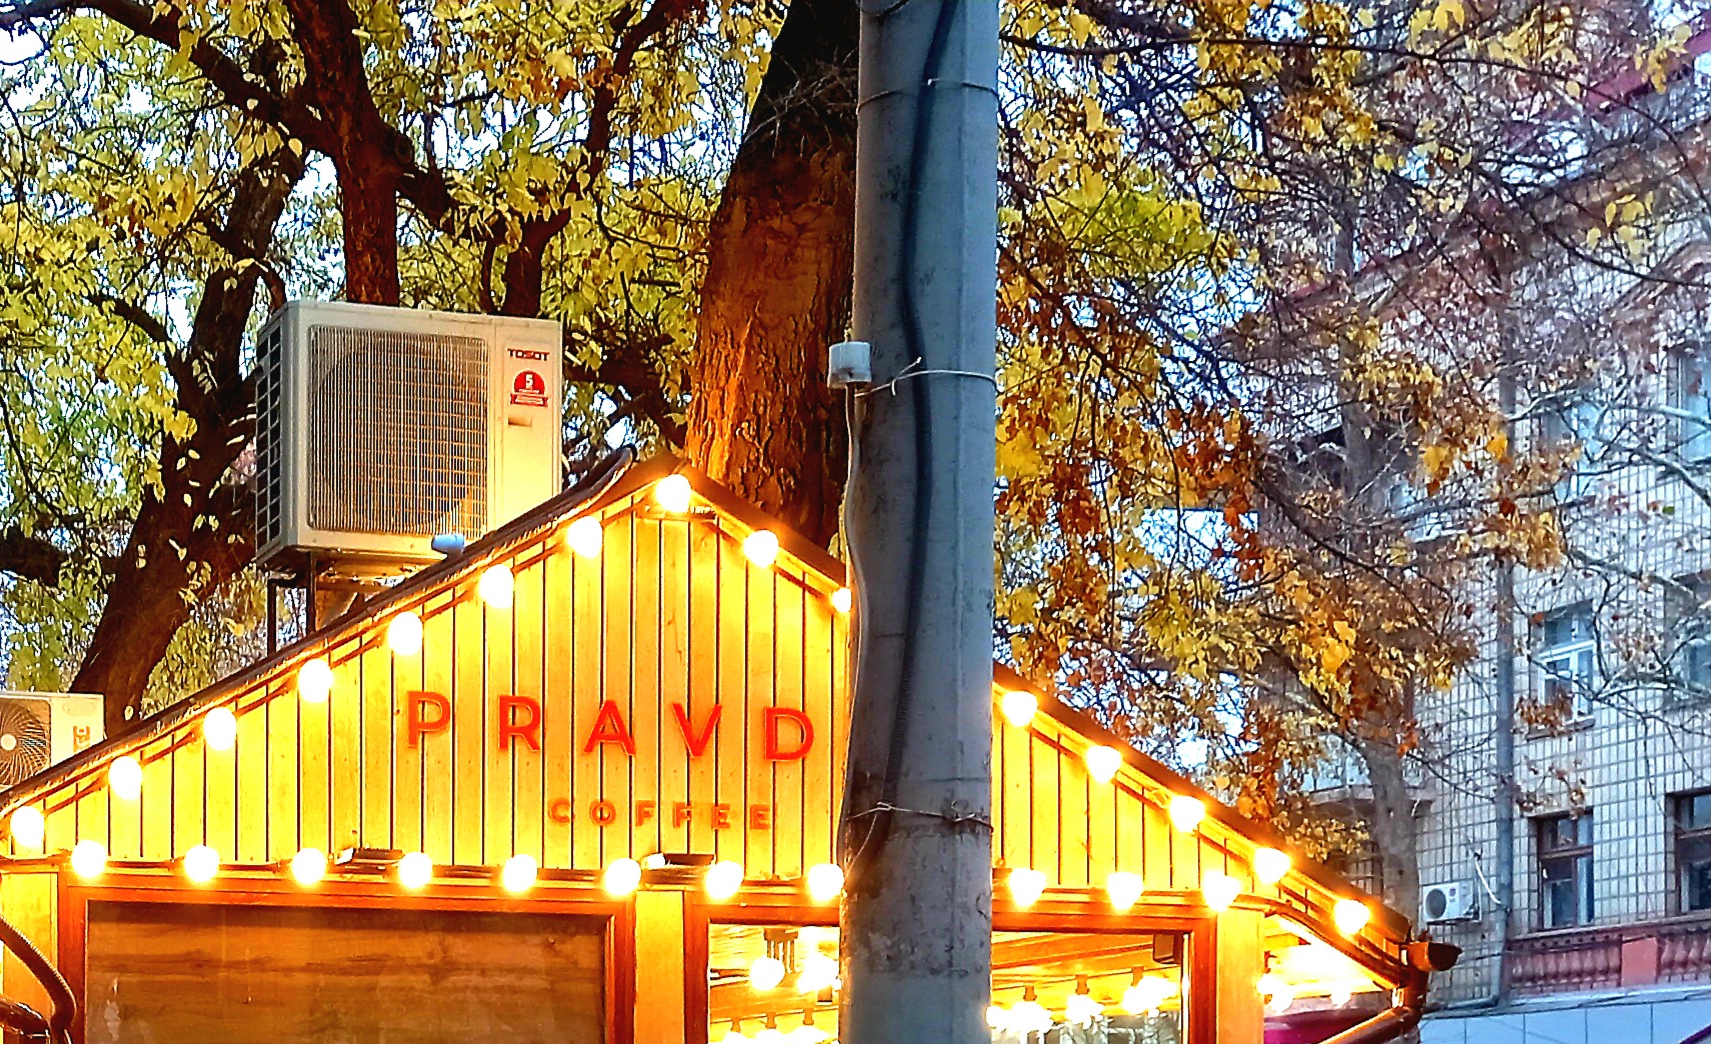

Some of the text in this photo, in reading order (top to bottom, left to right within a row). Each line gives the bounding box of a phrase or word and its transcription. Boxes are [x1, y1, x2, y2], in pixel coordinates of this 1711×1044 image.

[507, 348, 550, 361] TOSOT
[525, 374, 534, 389] 5
[406, 690, 816, 762] PRAVD
[548, 800, 772, 830] COFFEE
